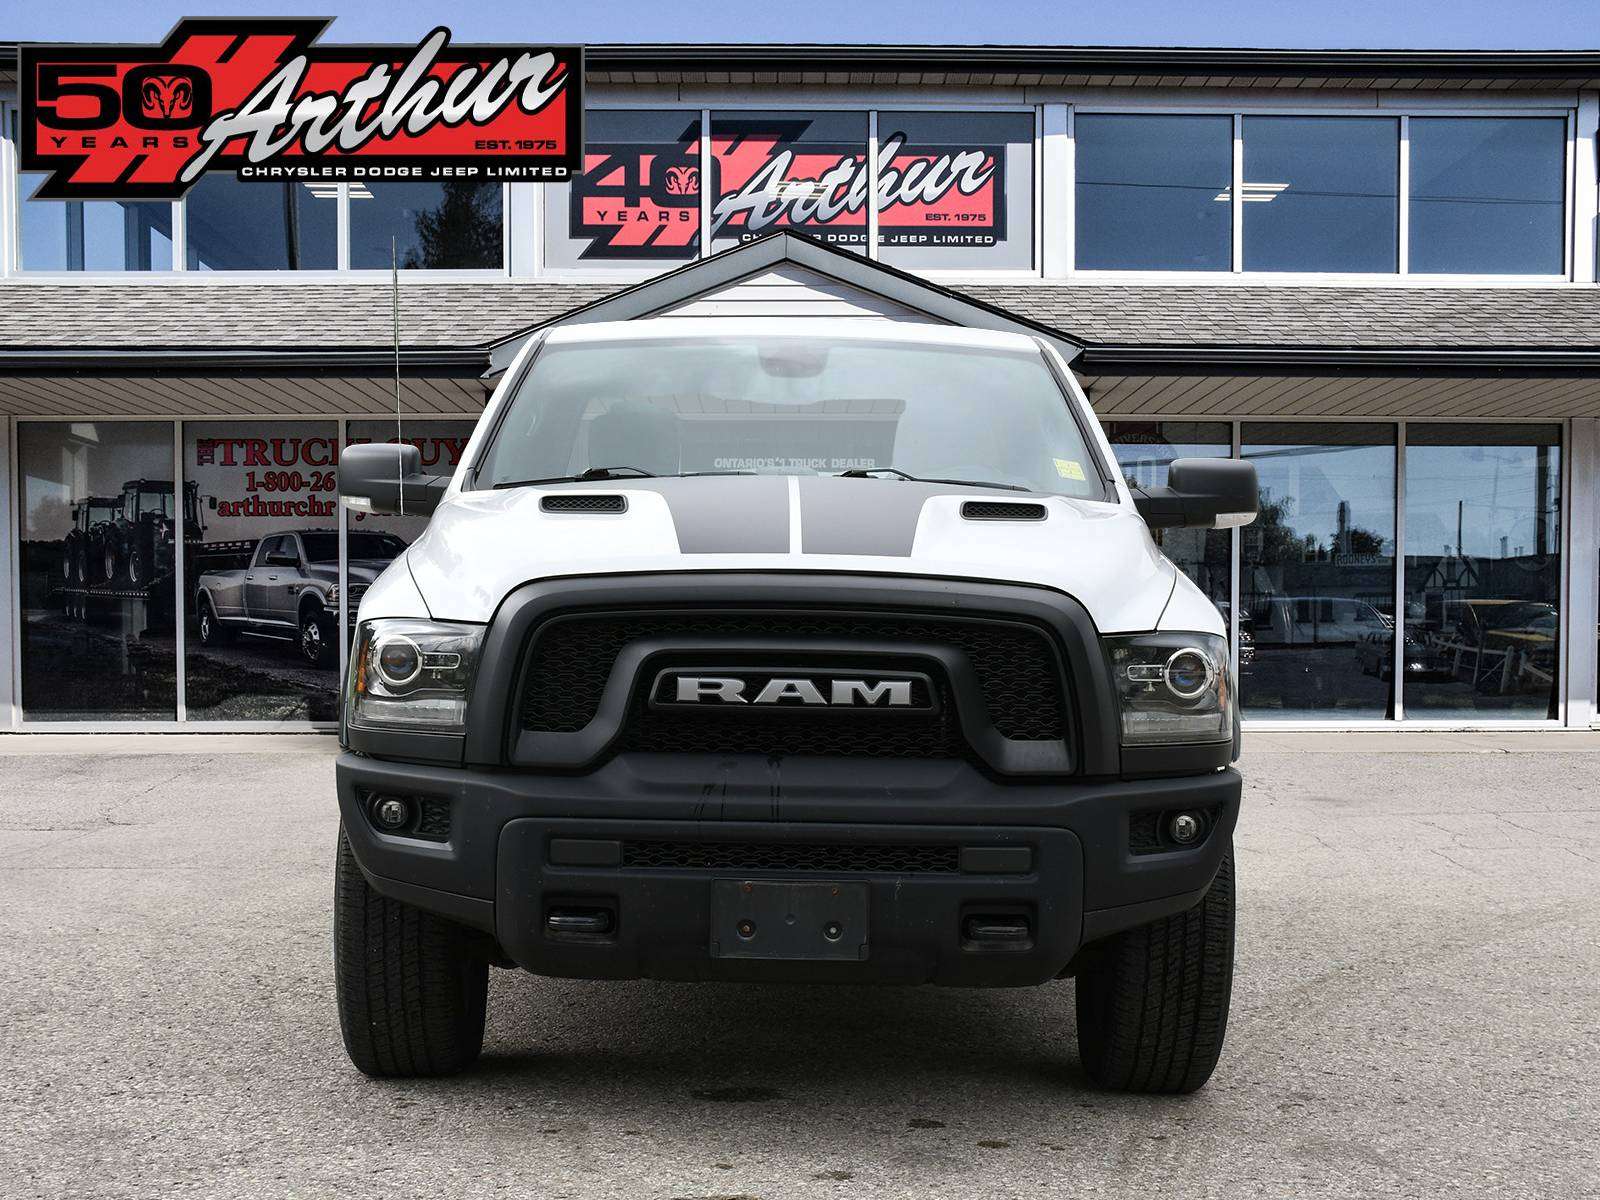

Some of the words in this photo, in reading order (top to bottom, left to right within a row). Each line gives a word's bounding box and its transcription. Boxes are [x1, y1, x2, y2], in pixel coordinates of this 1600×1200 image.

[572, 151, 721, 208] 40
[711, 136, 996, 231] Arthur
[596, 210, 690, 222] YEARS
[925, 213, 951, 221] EST.
[954, 213, 987, 221] 1975
[886, 235, 928, 243] JEEP
[788, 457, 826, 468] TRUCK
[831, 458, 876, 468] DEALER
[677, 677, 912, 704] RAM
